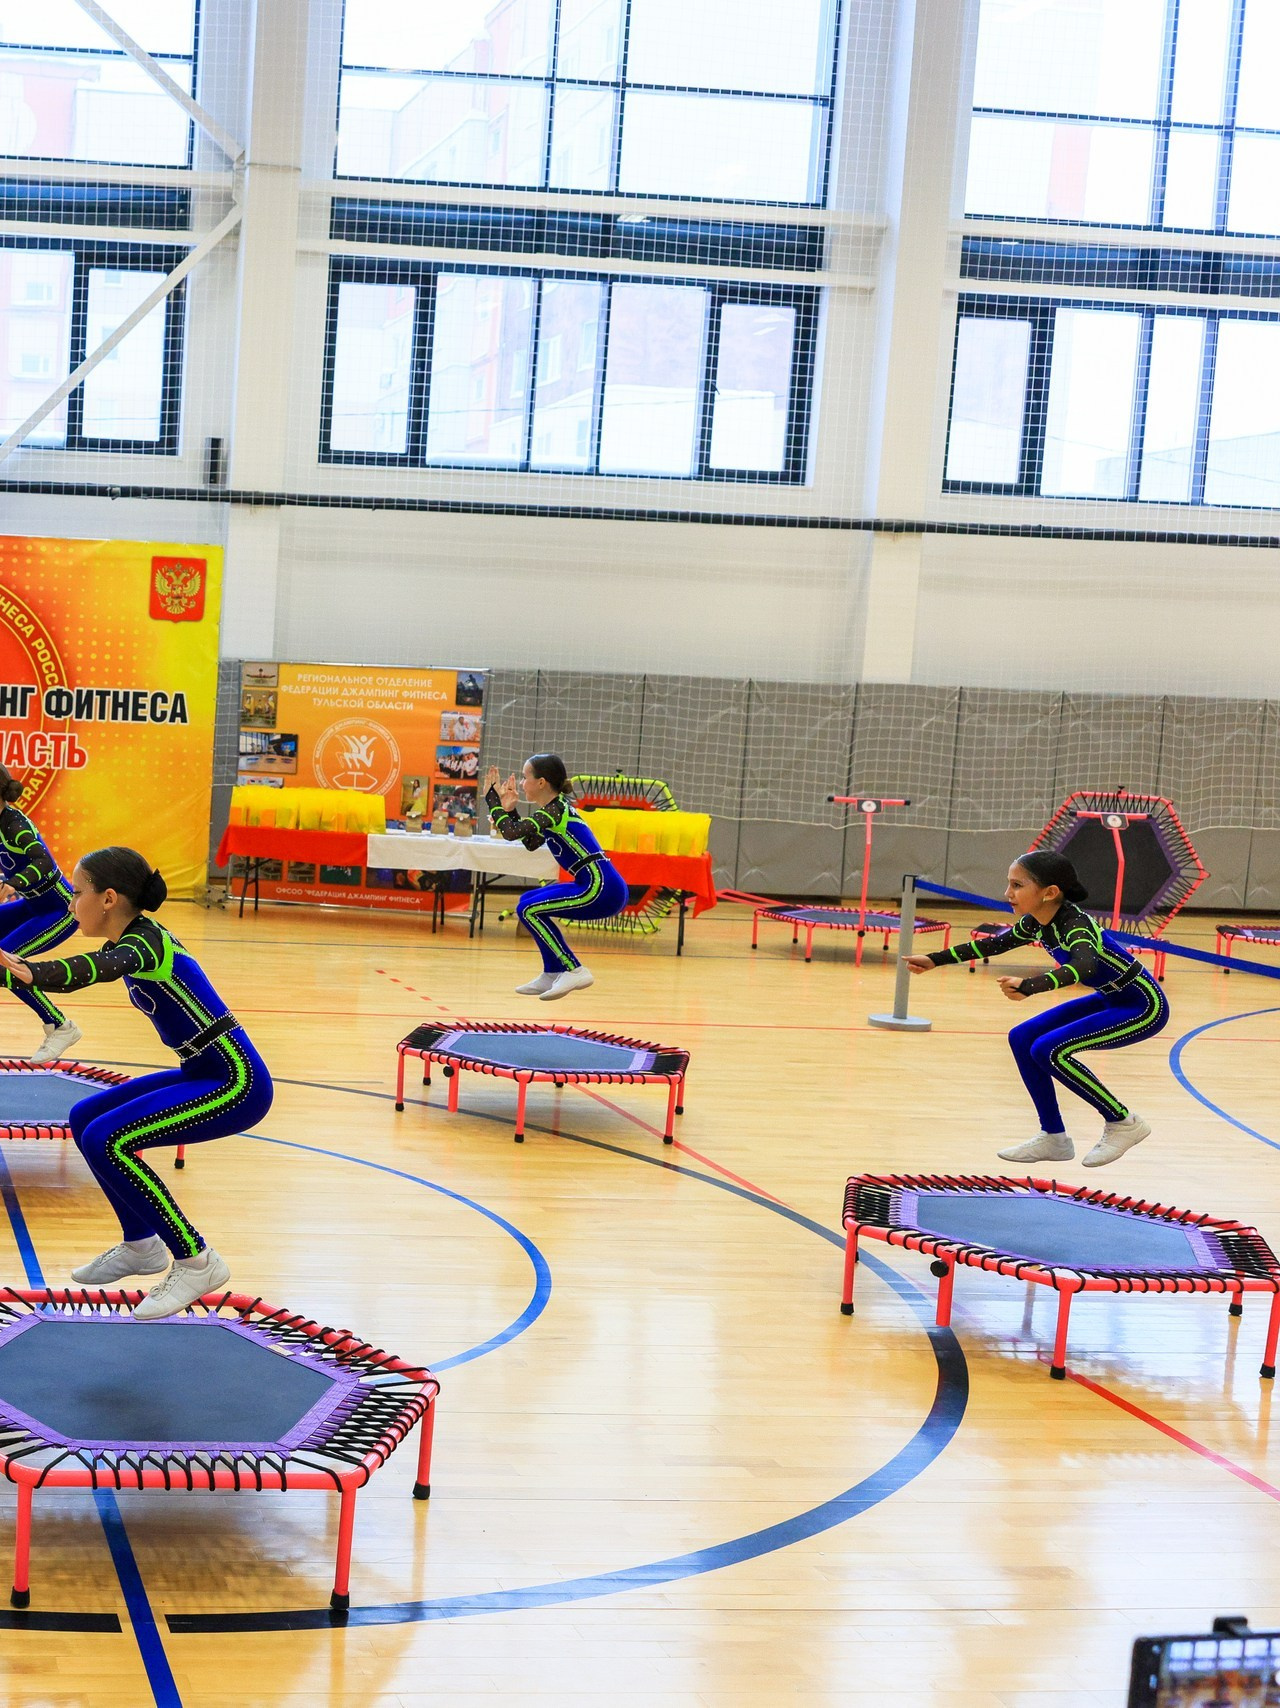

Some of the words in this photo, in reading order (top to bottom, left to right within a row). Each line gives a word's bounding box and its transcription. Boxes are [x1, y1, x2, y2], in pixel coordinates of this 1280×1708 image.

[30, 637, 60, 687] РОСС
[297, 673, 373, 686] РЕГИОНАЛЬНОЕ
[375, 676, 433, 688] ОТДЕЛЕНИЕ
[281, 684, 339, 695] ФЕДЕРАЦИИ
[341, 687, 399, 698] ДЖАМПИНГ
[402, 690, 448, 701] ФИТНЕСА
[44, 686, 189, 724] ФИТНЕСА
[312, 697, 364, 708] ТУЛЬСКОЙ
[366, 700, 414, 711] ОБЛАСТИ
[347, 892, 388, 902] ДЖАМПИНГ
